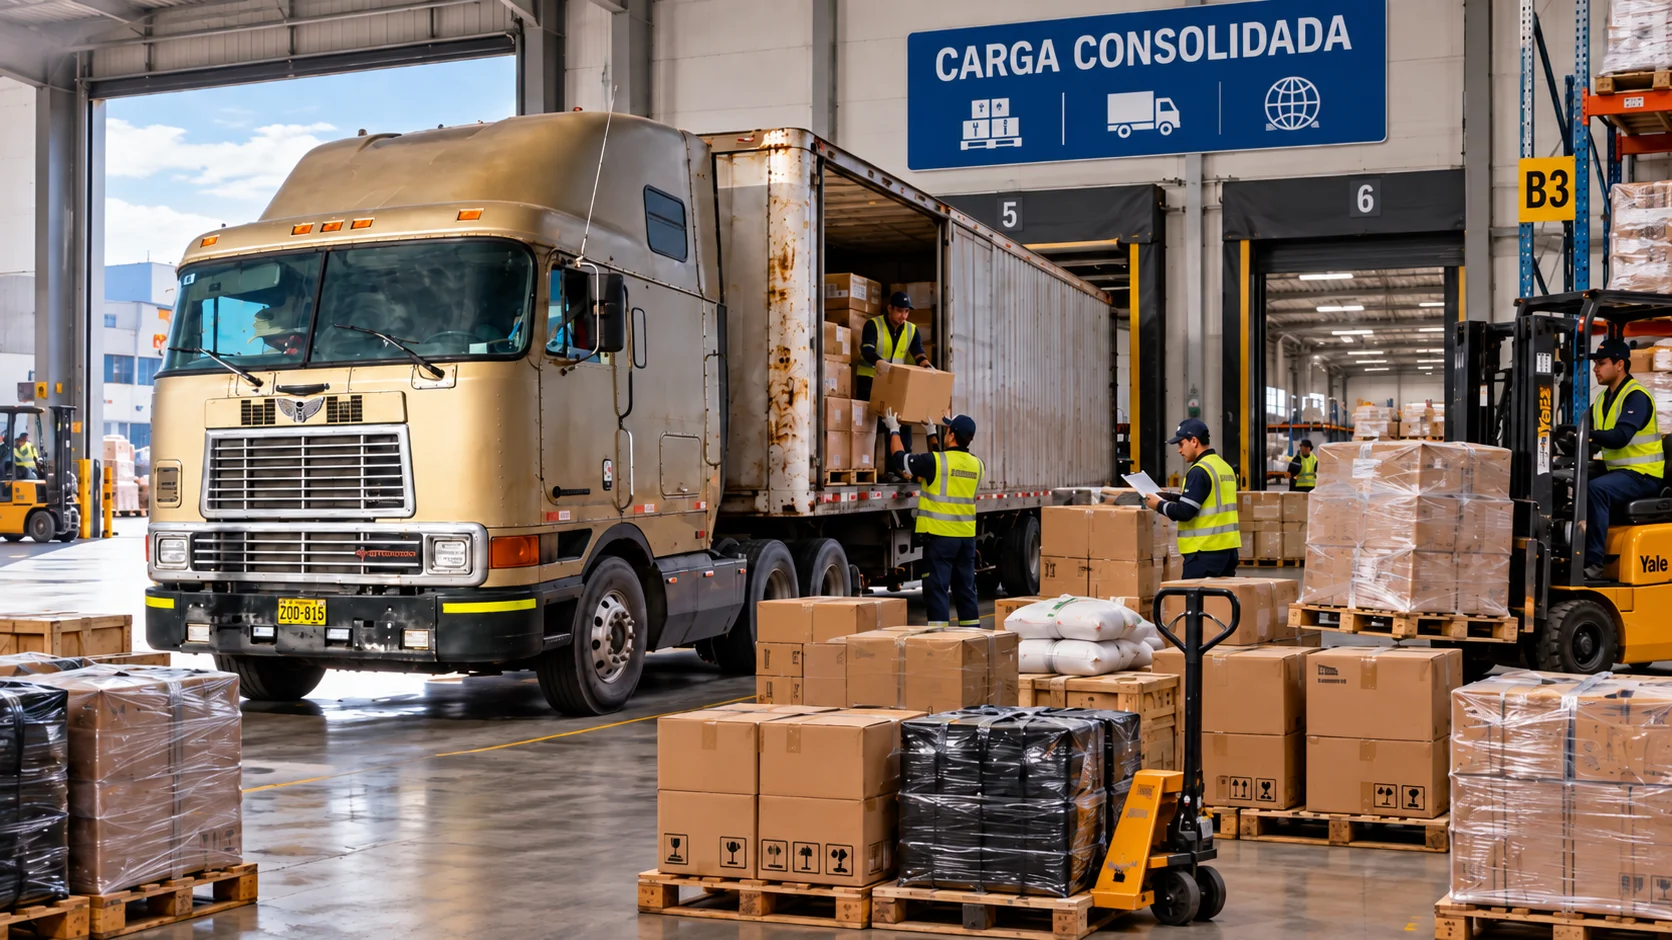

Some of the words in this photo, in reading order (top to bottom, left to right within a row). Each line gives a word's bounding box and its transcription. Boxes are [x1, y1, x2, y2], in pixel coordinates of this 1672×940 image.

[935, 38, 1060, 82] CARGA
[1074, 15, 1352, 70] CONSOLIDADA
[1357, 184, 1374, 213] 6
[1527, 169, 1569, 209] B3
[1002, 201, 1018, 228] 5
[1640, 554, 1669, 573] Yale
